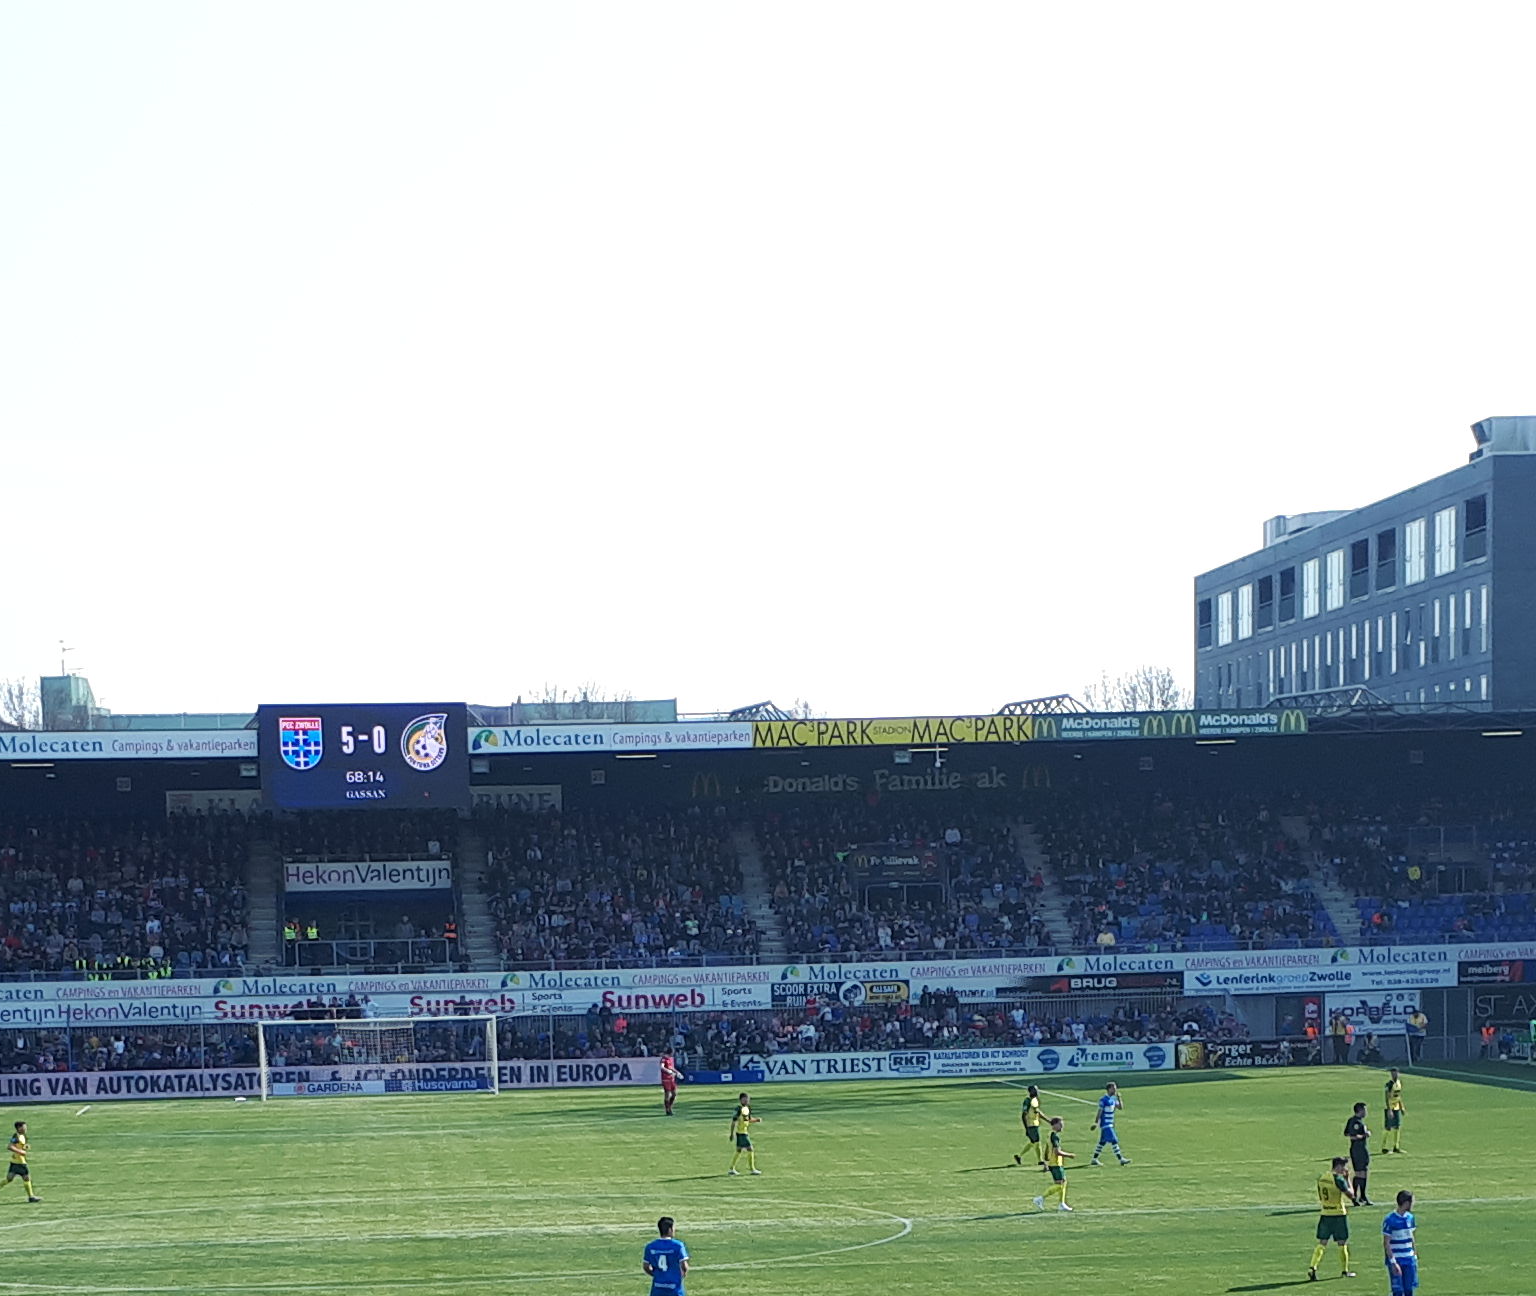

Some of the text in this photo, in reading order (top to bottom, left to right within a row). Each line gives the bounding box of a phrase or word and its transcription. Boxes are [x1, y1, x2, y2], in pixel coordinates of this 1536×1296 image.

[1061, 717, 1141, 728] McDonald's
[1199, 713, 1278, 726] McDonald's
[503, 728, 751, 747] Molecaten Campings & vakantieparken
[873, 725, 911, 735] STADION
[112, 738, 164, 755] Campings
[166, 739, 174, 751] &
[177, 737, 256, 754] vakantieparken
[346, 771, 384, 783] 68:14
[346, 789, 386, 799] GASSAN
[284, 862, 451, 888] HekonValentijn
[1083, 956, 1174, 973] Molecaten
[1185, 957, 1231, 970] CAMPINGS
[1244, 954, 1320, 968] VAKANTIEPARKEN
[1358, 947, 1448, 964] Molecaten
[1458, 949, 1506, 961] CAMPINGS
[529, 973, 621, 989] Molecaten
[632, 974, 679, 986] CAMPINGS
[693, 970, 770, 985] VAKANTIEPARKEN
[808, 965, 900, 982] Molecaten
[910, 966, 957, 978] CAMPINGS
[971, 962, 1046, 977] VAKANTIEPARKEN
[242, 978, 337, 995] Molecaten
[348, 981, 397, 993] CAMPINGS
[411, 978, 489, 992] VAKANTIEPARKEN
[773, 983, 806, 996] SCOOR
[1070, 977, 1118, 989] BRUG
[56, 987, 106, 999] CAMPINGS
[121, 984, 202, 998] VAKANTIEPARKEN
[531, 992, 563, 1002] Sports
[602, 988, 706, 1010] Sunweb
[721, 986, 753, 997] Sports
[58, 1001, 202, 1022] HekonValentijn
[1074, 1049, 1134, 1063] Breman
[764, 1059, 811, 1076] VAN
[811, 1056, 887, 1074] TRIEST
[892, 1054, 928, 1067] RKR
[47, 1076, 88, 1095] VAN
[529, 1065, 549, 1084] IN
[556, 1062, 633, 1083] EUROPA
[415, 1079, 478, 1091] Husqvarna
[307, 1082, 363, 1094] GARDENA
[658, 1254, 668, 1272] 4
